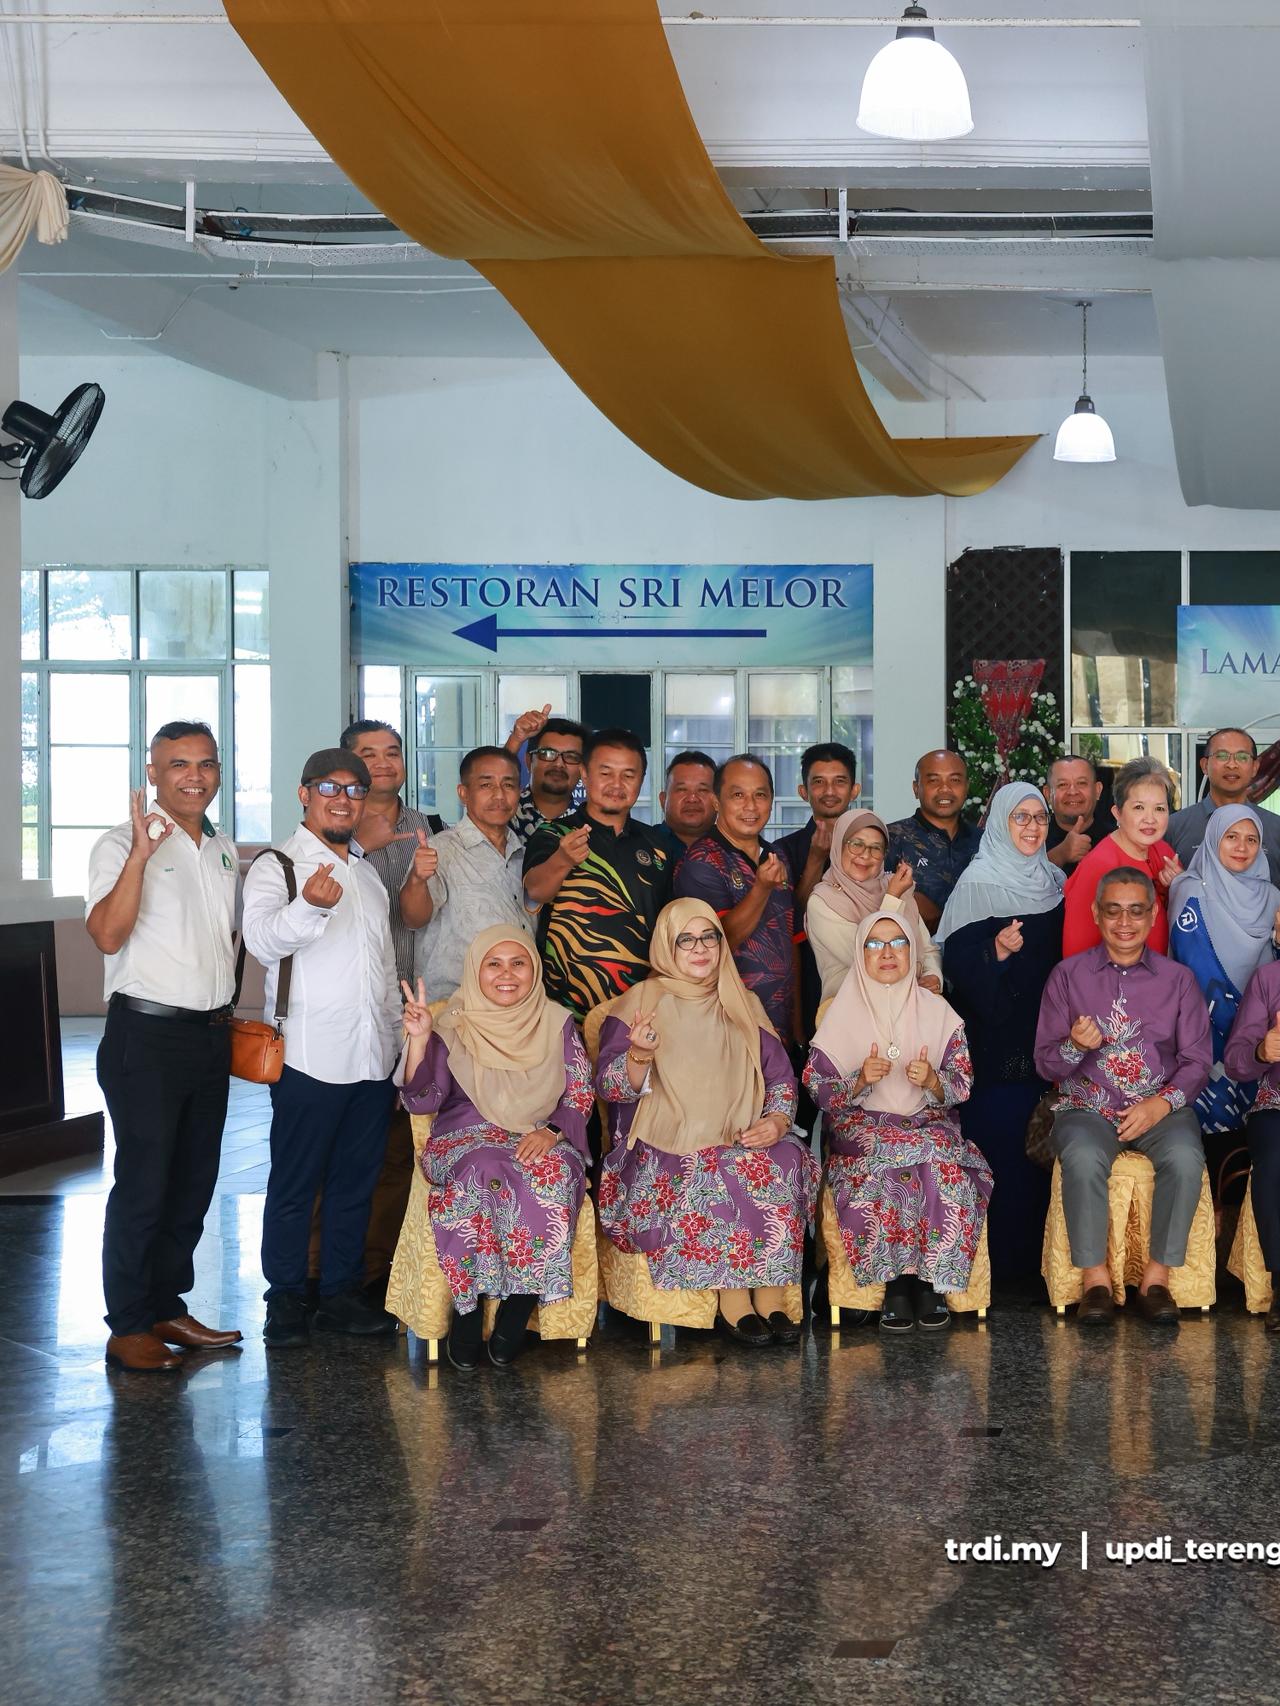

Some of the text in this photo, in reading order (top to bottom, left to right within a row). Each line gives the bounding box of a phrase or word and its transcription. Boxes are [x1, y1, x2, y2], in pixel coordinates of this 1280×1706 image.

[377, 577, 849, 608] RESTORAN SRI MELOR
